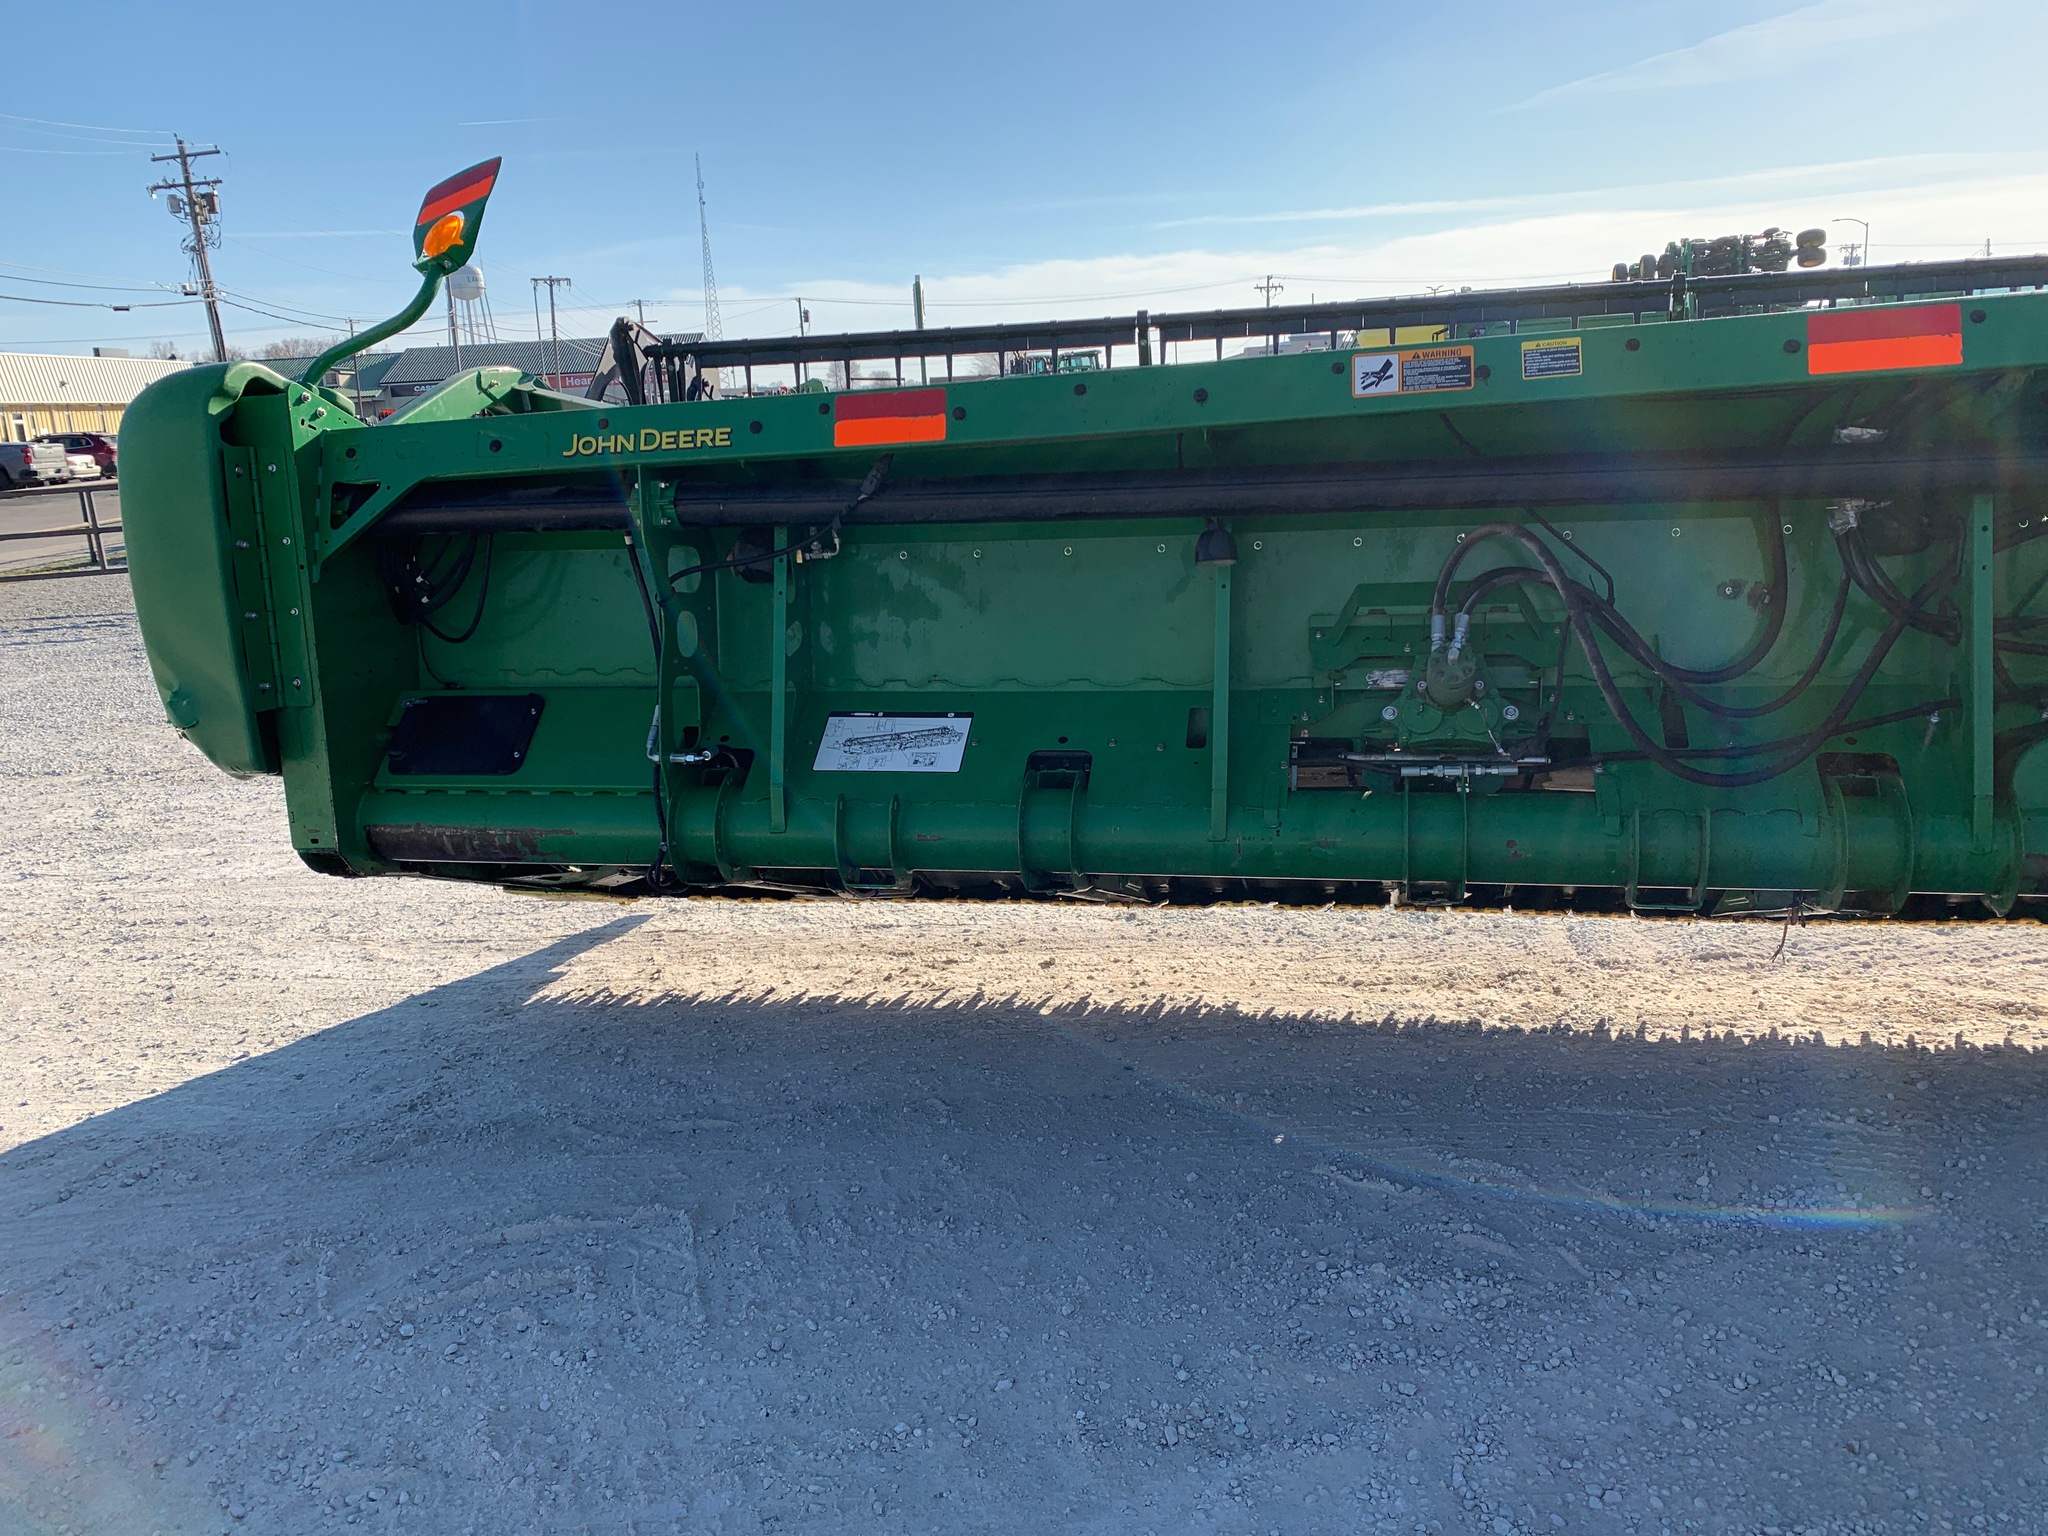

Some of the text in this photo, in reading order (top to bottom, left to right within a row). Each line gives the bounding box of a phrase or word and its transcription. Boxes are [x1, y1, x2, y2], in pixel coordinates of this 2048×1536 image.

[1542, 340, 1568, 348] CAUTION
[1422, 348, 1462, 359] WARNING
[562, 427, 732, 457] JOHN DEERE
